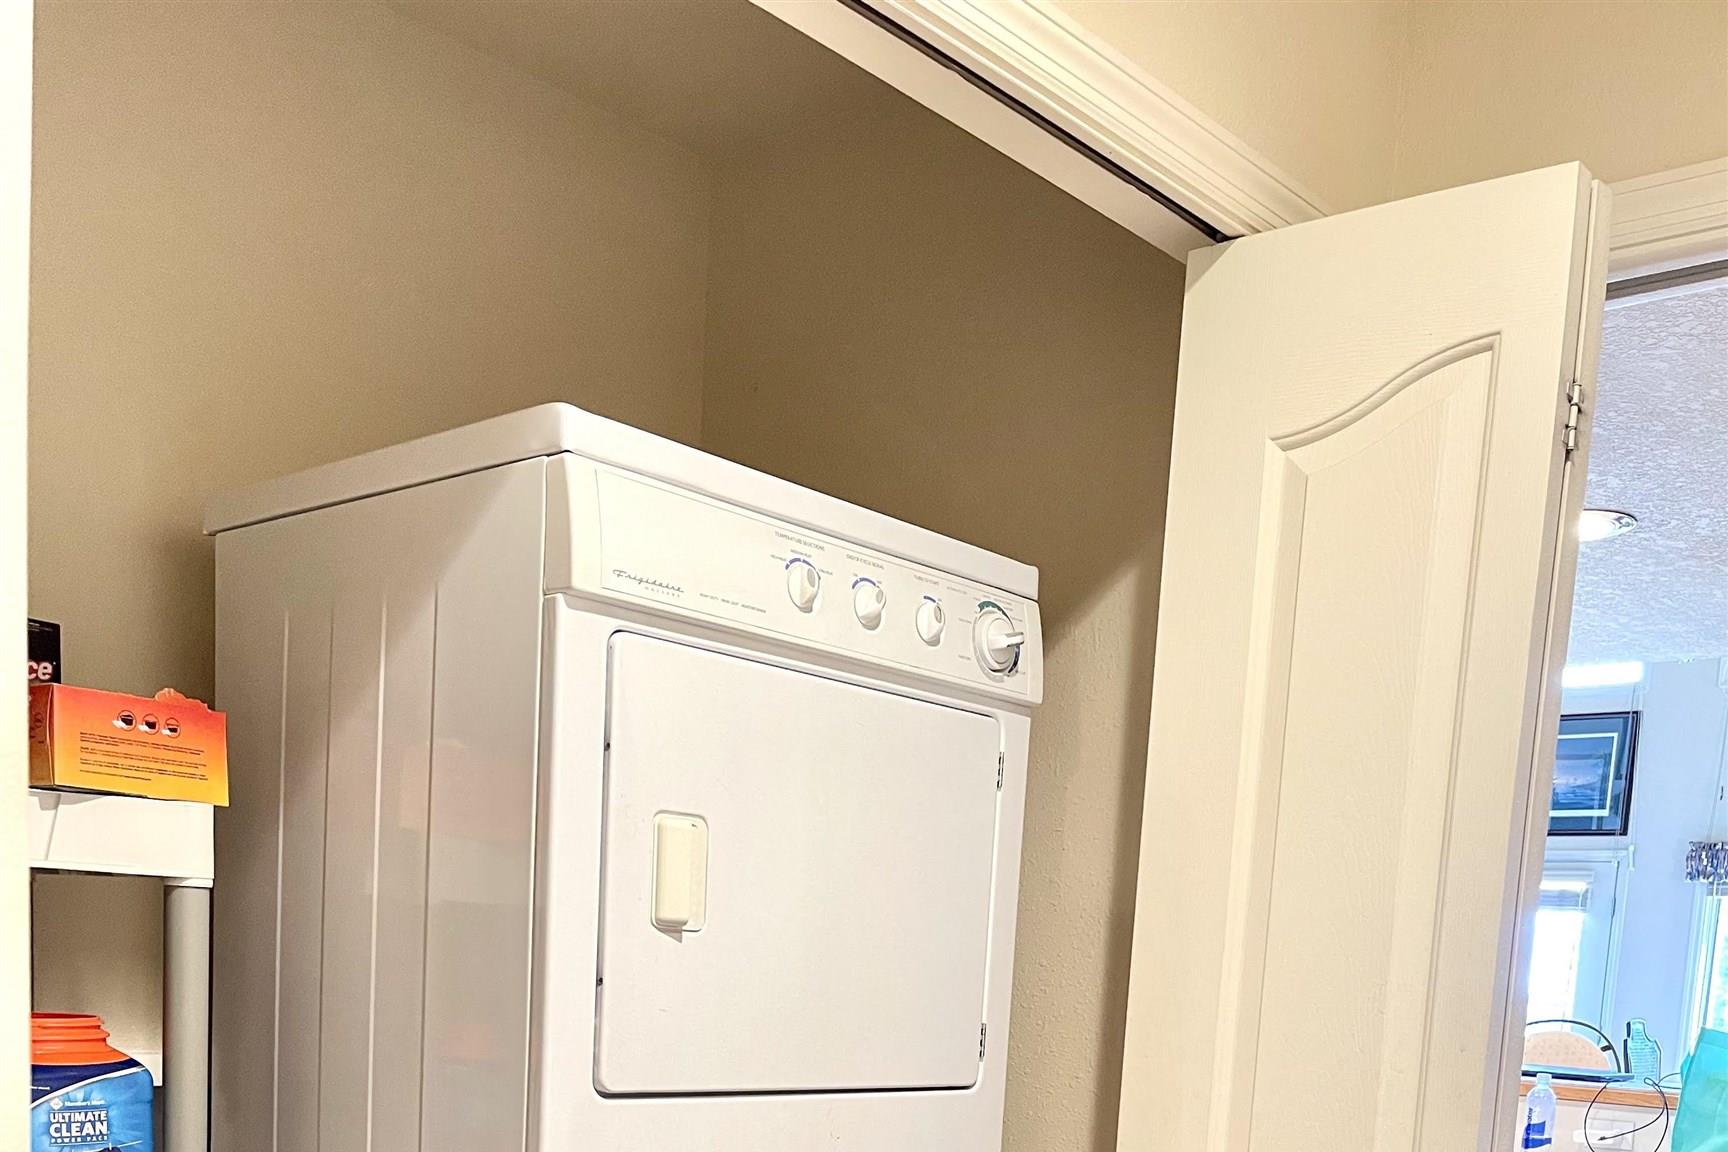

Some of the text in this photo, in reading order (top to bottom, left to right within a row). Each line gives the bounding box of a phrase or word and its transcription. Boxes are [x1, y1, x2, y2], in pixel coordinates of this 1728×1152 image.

[612, 569, 685, 593] Frigidaire
[49, 1110, 108, 1123] ULTIMATE
[49, 1122, 109, 1138] CLEAN
[50, 1136, 83, 1144] POWER
